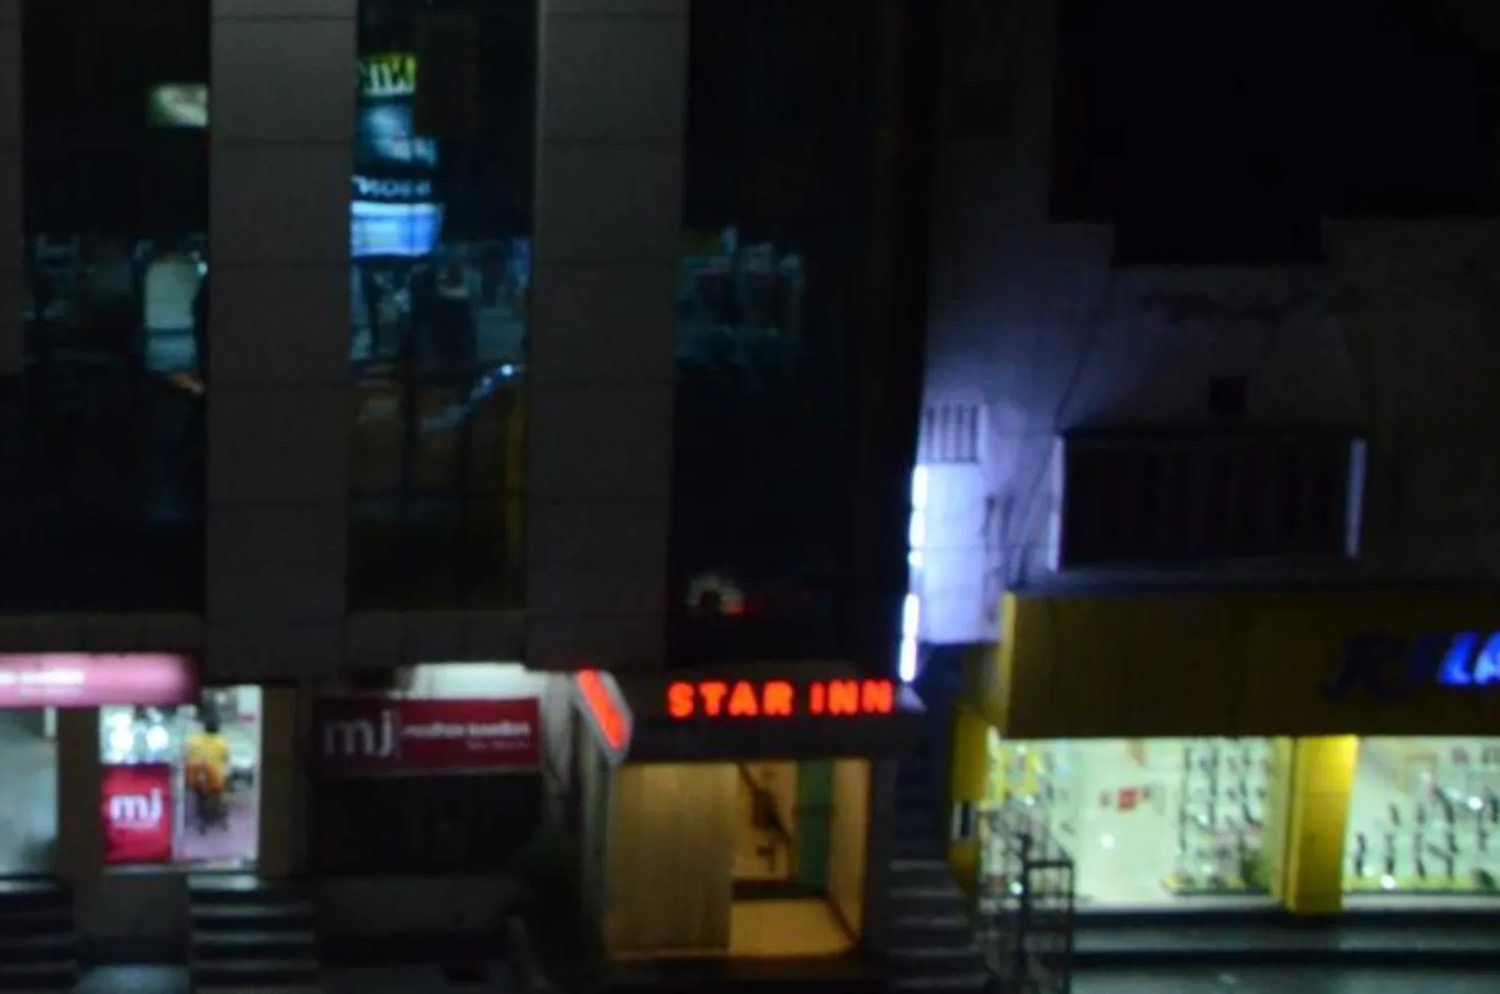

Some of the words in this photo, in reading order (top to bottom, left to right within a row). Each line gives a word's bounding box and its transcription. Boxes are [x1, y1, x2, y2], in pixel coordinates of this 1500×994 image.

[667, 680, 795, 719] STAR
[809, 679, 894, 716] INN
[323, 709, 397, 757] mj
[109, 787, 163, 829] mj
